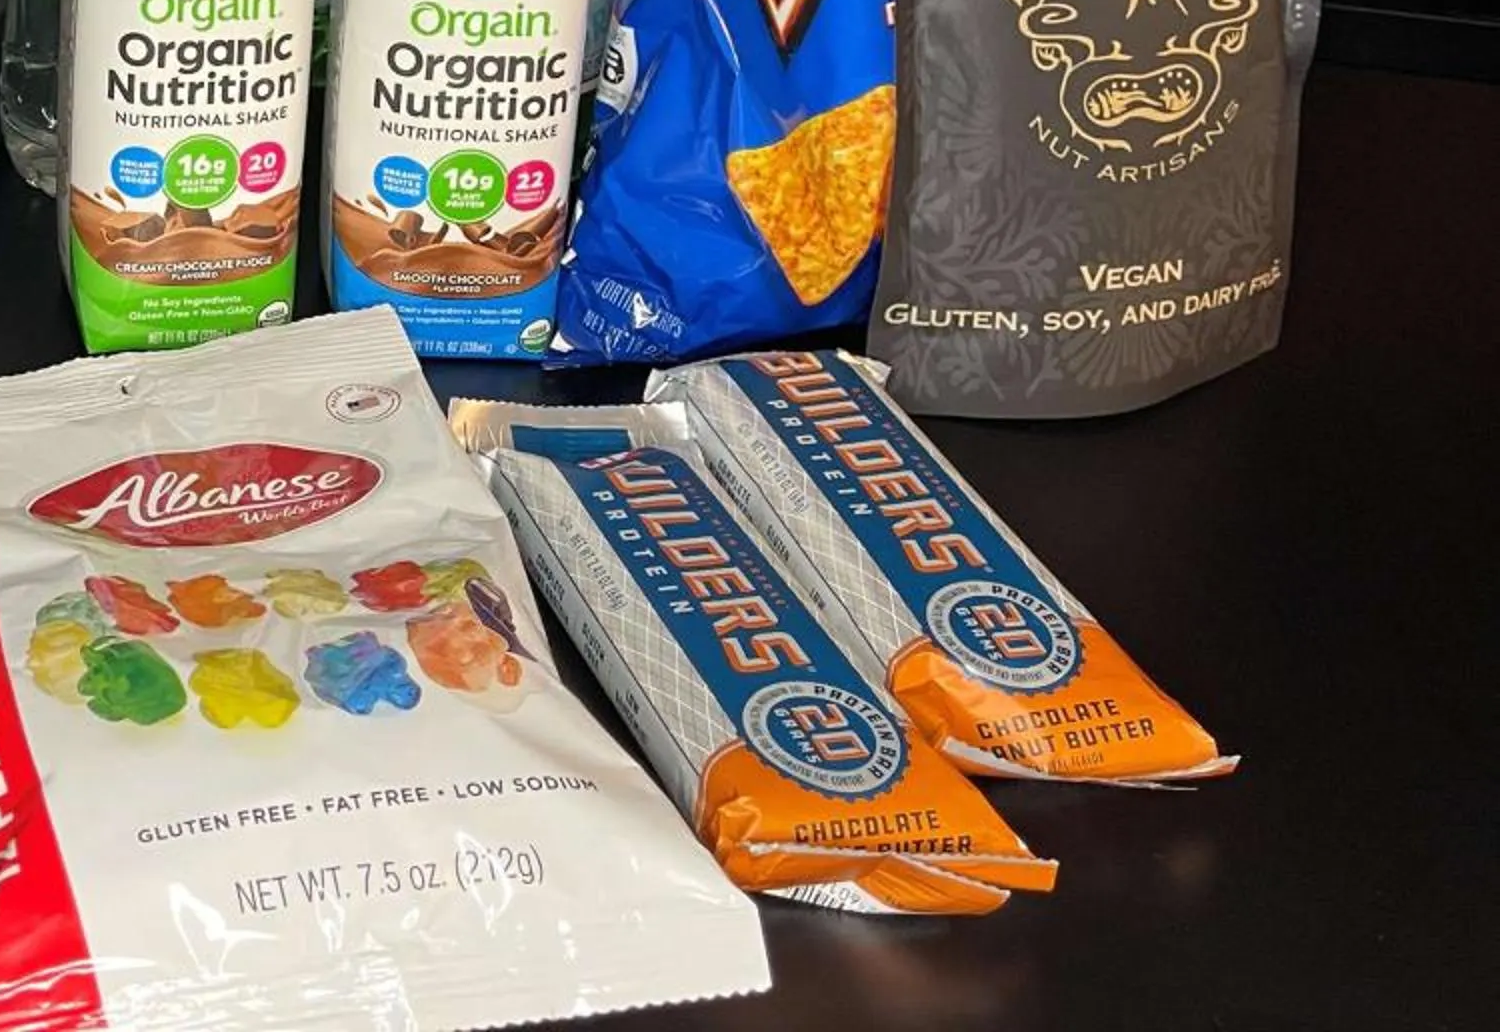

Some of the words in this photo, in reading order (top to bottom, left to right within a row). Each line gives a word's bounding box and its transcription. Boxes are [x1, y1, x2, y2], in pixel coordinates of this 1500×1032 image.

[409, 0, 552, 47] Orgain
[118, 30, 294, 76] Organic
[386, 41, 568, 89] Organic
[107, 69, 297, 107] Nutrition
[372, 77, 568, 121] Nutrition
[115, 111, 233, 130] NUTRITIONAL
[235, 106, 289, 127] SHAKE
[380, 119, 501, 144] NUTRITIONAL
[504, 123, 559, 143] SHAKE
[1029, 115, 1090, 170] NUT
[1096, 98, 1242, 183] ARTISANS
[176, 152, 228, 178] 16g
[249, 151, 277, 173] 20
[443, 167, 496, 192] 16g
[514, 170, 546, 190] 22
[115, 261, 165, 274] CREAMY
[166, 257, 235, 273] CHOCOLATE
[235, 254, 274, 269] FUDGE
[393, 270, 448, 285] SMOOTH
[449, 272, 523, 286] CHOCOLATE
[1078, 259, 1184, 293] VEGAN
[883, 302, 1030, 340] GLUTEN,
[1042, 308, 1112, 336] SOY,
[1120, 299, 1177, 327] AND
[1183, 283, 1244, 317] DAIRY
[750, 352, 988, 575] BUILDERS
[766, 398, 873, 517] PROTEIN
[65, 468, 353, 528] Albanese
[585, 450, 811, 674] UILDERS
[591, 489, 695, 615] PROTEIN
[955, 607, 1003, 661] GRAMS
[971, 602, 1047, 658] 20
[991, 585, 1067, 638] PROTEIN
[1048, 646, 1071, 675] BAR
[773, 707, 823, 764] GRAMS
[790, 703, 870, 761] 20
[813, 685, 896, 742] PROTEIN
[867, 745, 897, 780] BAR
[976, 699, 1120, 740] CHOCOLATE
[980, 735, 1058, 762] ANUT
[1065, 717, 1156, 750] BUTTER
[137, 813, 231, 844] GLUTEN
[238, 803, 298, 827] FREE
[321, 793, 363, 815] FAT
[370, 786, 430, 810] FREE
[453, 778, 504, 800] LOW
[512, 774, 599, 794] SODIUM
[794, 809, 942, 844] CHOCOLATE
[234, 873, 289, 916] NET
[297, 866, 352, 904] WT.
[356, 861, 402, 897] 7.5
[453, 842, 545, 894] (212g)
